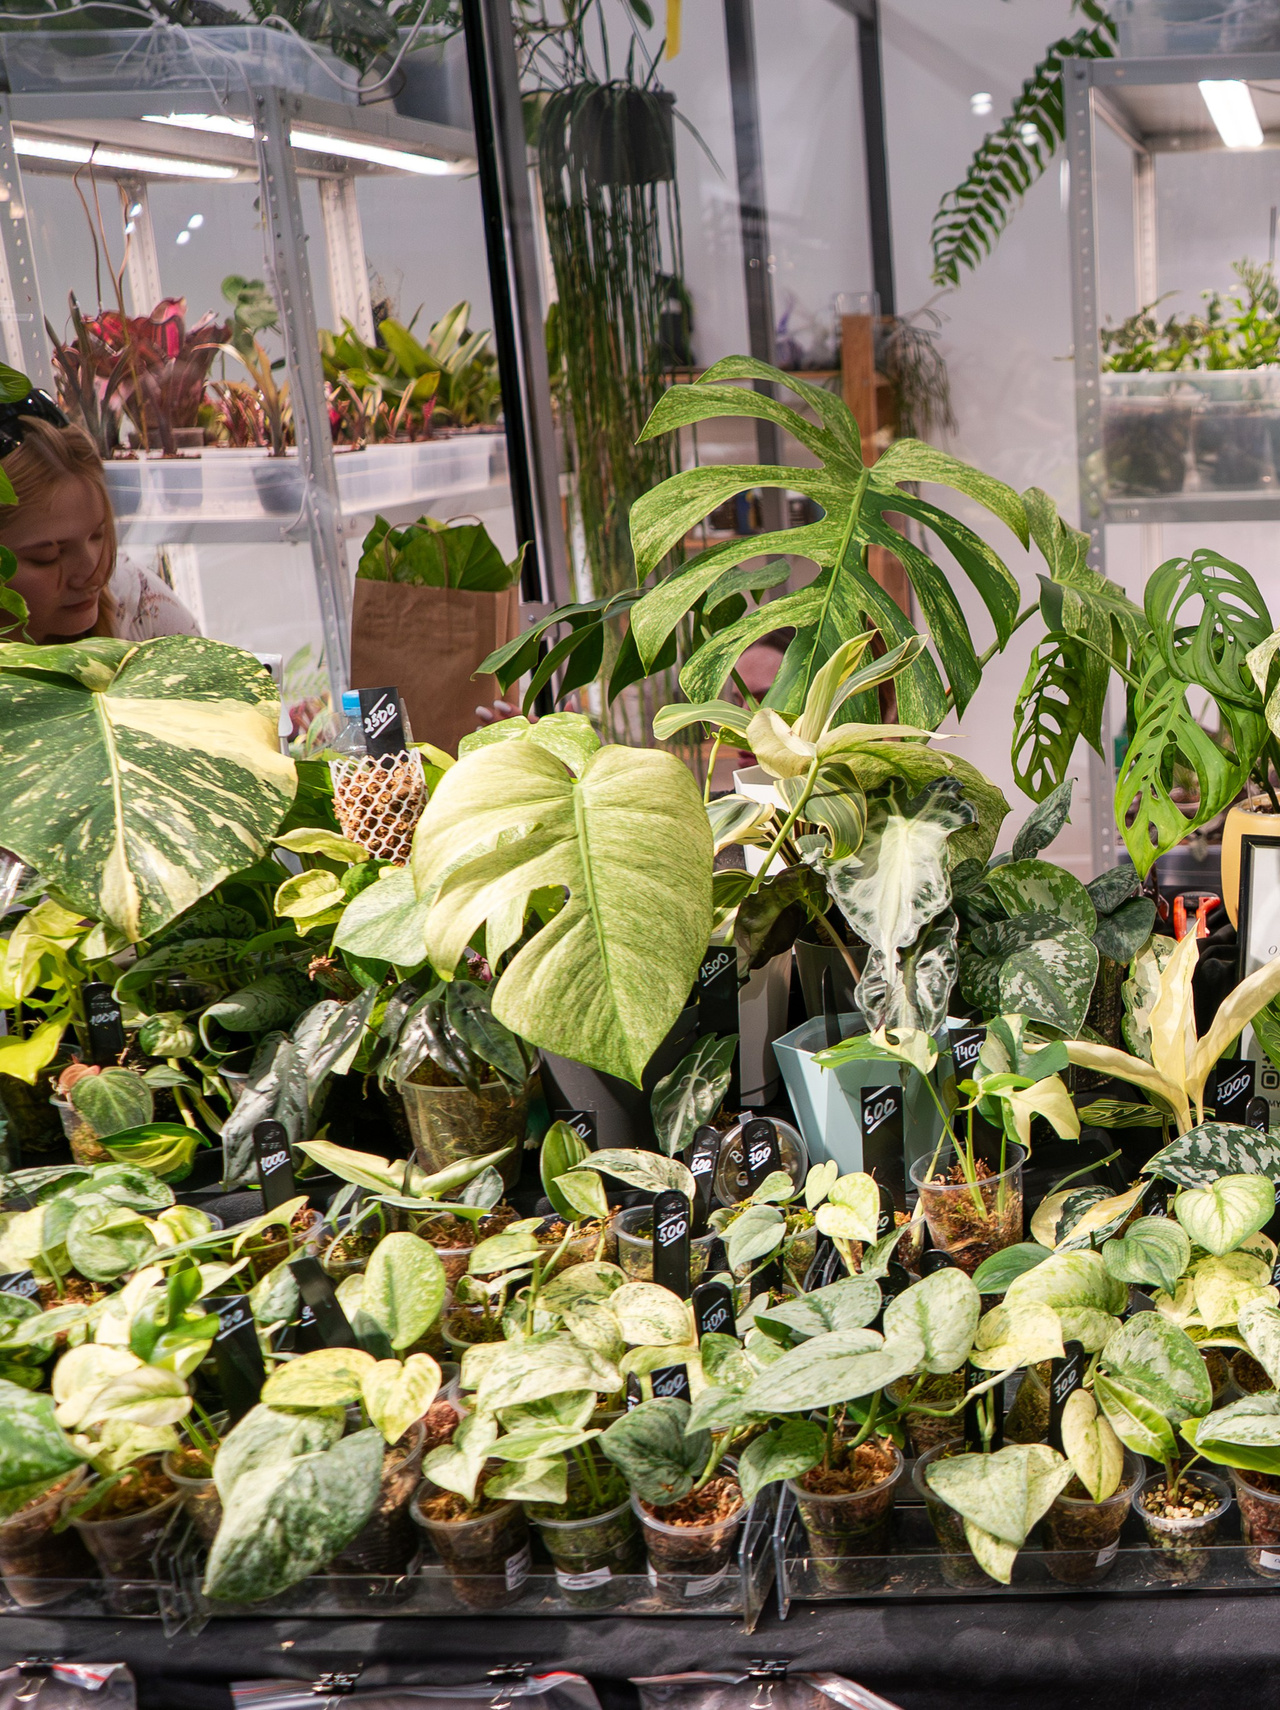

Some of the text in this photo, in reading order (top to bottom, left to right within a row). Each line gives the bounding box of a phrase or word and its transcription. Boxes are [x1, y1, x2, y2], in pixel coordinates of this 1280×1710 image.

[364, 703, 396, 734] 2500
[700, 952, 729, 979] 1500
[1217, 1074, 1251, 1101] 2000
[863, 1097, 896, 1126] 600
[260, 1150, 287, 1171] 1000
[690, 1157, 712, 1172] 600
[748, 1146, 772, 1165] 700
[658, 1220, 687, 1243] 500
[702, 1308, 727, 1332] 400
